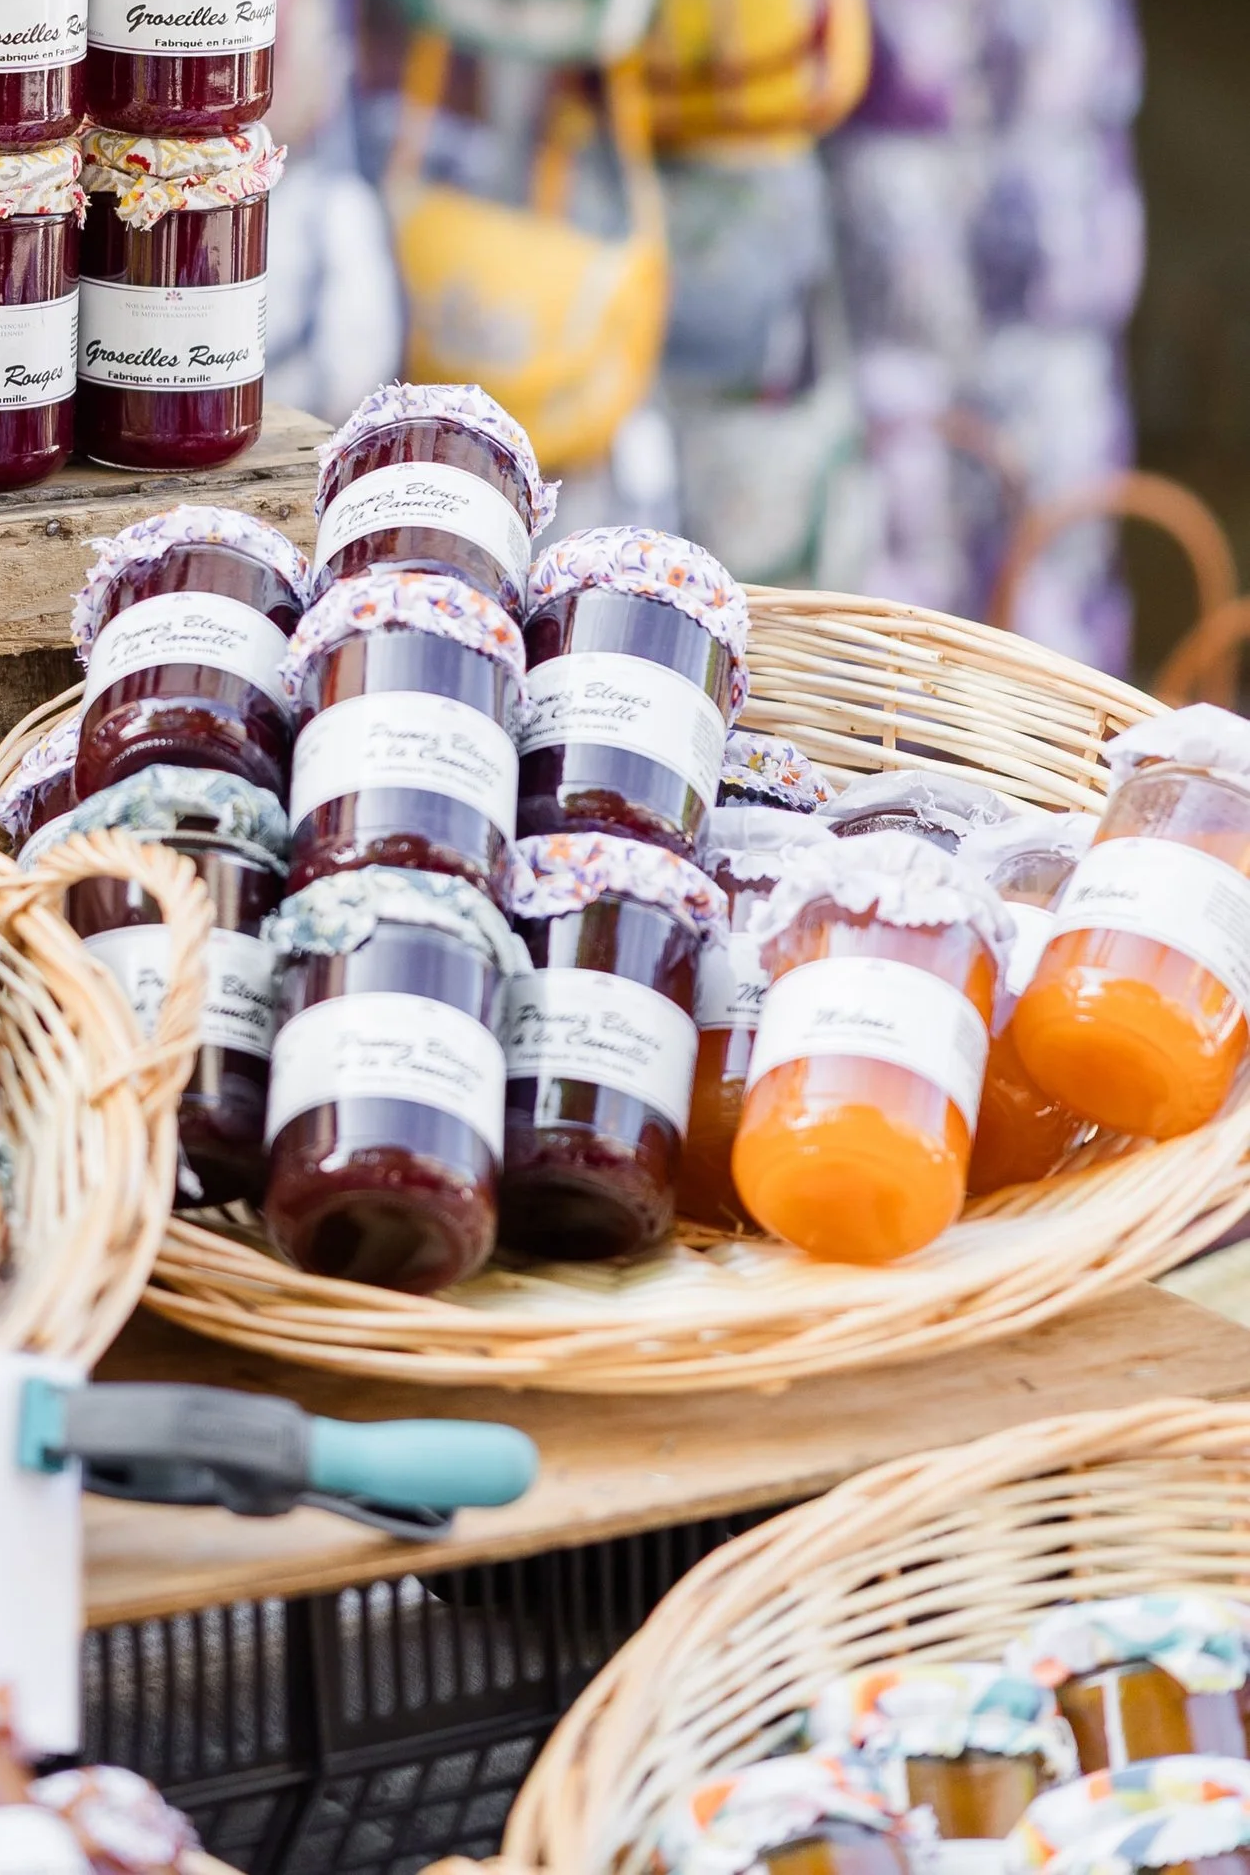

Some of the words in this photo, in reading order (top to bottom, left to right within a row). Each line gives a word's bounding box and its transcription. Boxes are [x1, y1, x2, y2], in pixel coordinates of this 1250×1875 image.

[126, 4, 228, 32] Groseilles
[42, 50, 53, 58] en
[56, 45, 80, 56] Famille
[155, 39, 203, 48] Fabriqué
[222, 36, 252, 45] Famille
[86, 340, 180, 367] Groseilles
[188, 345, 250, 371] Rouges
[4, 365, 63, 391] Rouges
[108, 371, 152, 383] Fabriqué
[174, 375, 211, 383] Famille
